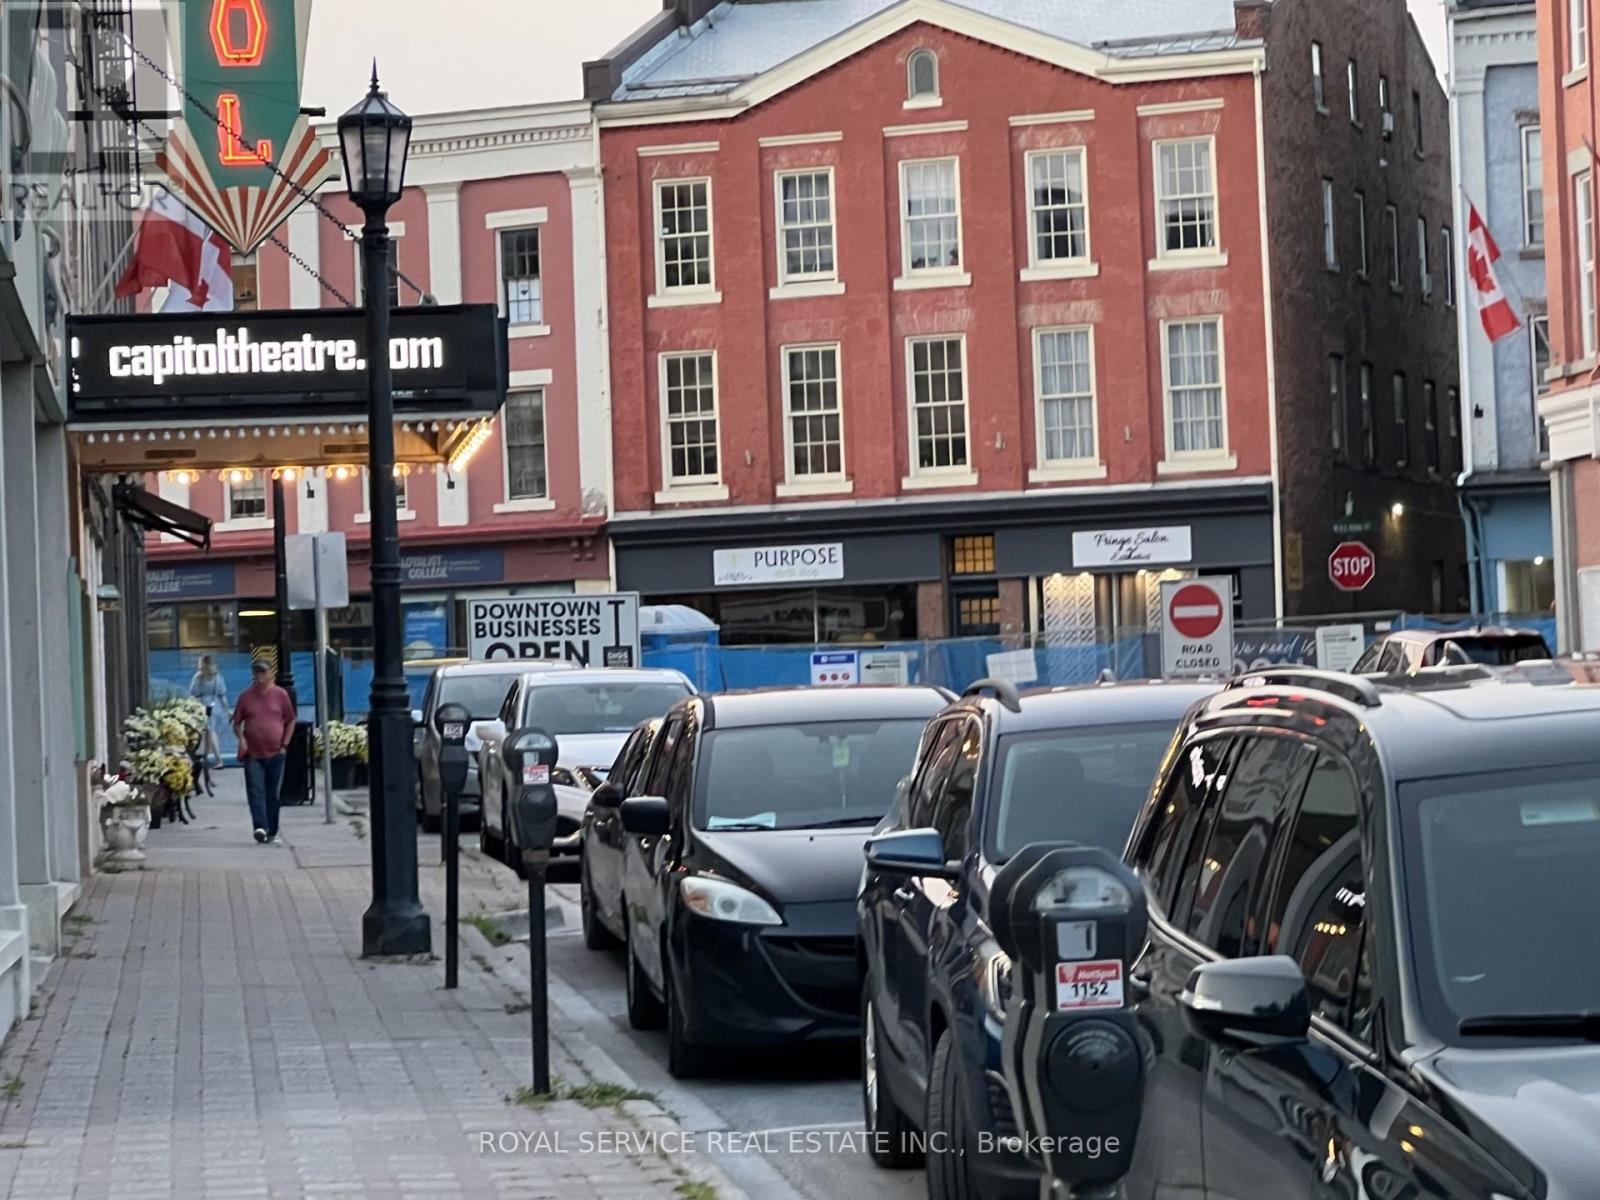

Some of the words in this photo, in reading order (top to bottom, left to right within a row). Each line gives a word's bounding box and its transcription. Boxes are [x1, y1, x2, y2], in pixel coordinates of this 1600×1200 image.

[108, 327, 444, 386] capitoltheatre.om
[754, 546, 838, 568] PURPOSE
[1333, 556, 1370, 577] STOP
[474, 600, 601, 620] DOWNTOWN
[474, 618, 601, 639] BUSINESSES
[484, 639, 590, 668] OPEN
[1182, 644, 1213, 655] ROAD
[1175, 658, 1220, 669] CLOSED
[1071, 980, 1109, 998] 1152
